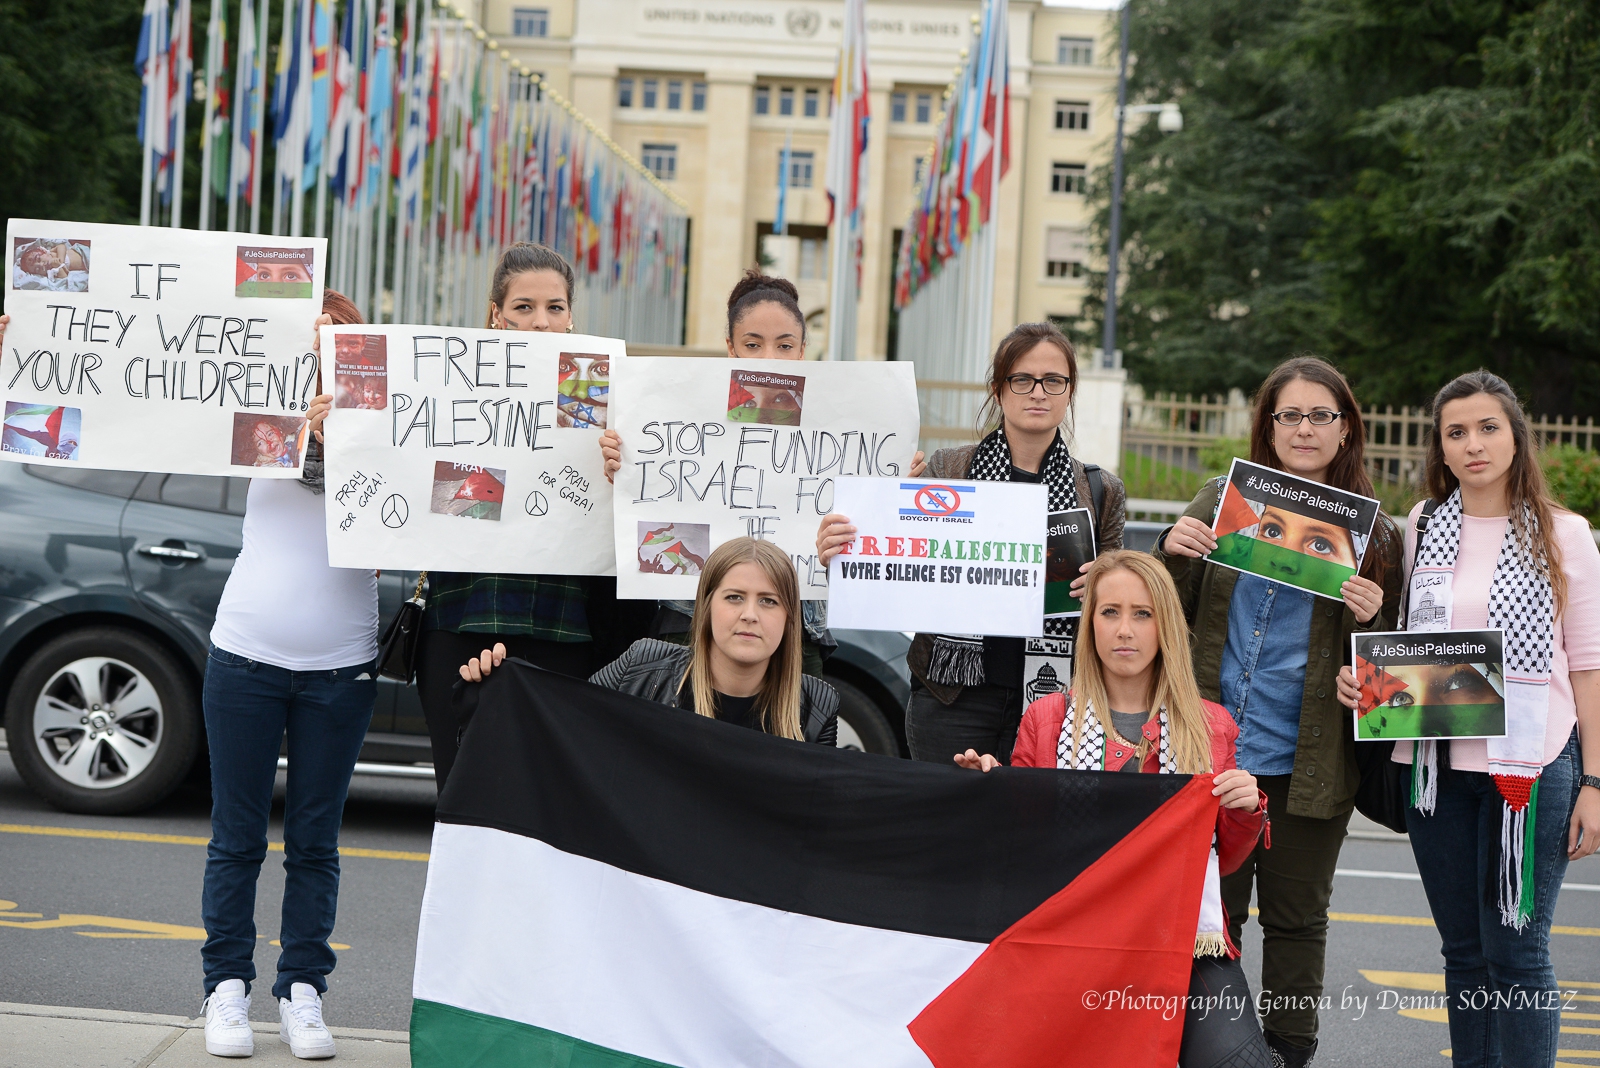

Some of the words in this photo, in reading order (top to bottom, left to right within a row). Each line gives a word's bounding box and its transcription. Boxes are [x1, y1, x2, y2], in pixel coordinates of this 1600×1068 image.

[828, 17, 905, 35] NONS
[244, 250, 306, 259] #JeSuisPalestine
[129, 263, 181, 301] IF
[46, 304, 137, 348] THEY
[156, 313, 268, 358] WERE
[7, 347, 103, 395] YOUR
[124, 352, 318, 412] CHILDREN!?
[412, 335, 529, 391] FREE
[738, 373, 797, 387] #JeSuisPalestine
[391, 393, 554, 452] PALESTINE
[637, 420, 726, 457] STOP
[736, 426, 900, 477] FUNDING
[453, 462, 484, 474] PRAY
[558, 465, 590, 493] PRAY
[335, 470, 368, 506] PRAY
[339, 512, 357, 532] FOR
[358, 472, 387, 507] GAZA!
[538, 470, 557, 488] FOR
[559, 486, 594, 516] GAZA!
[632, 459, 777, 510] ISRAEL
[795, 477, 835, 516] FO
[1246, 475, 1359, 519] #JeSuisPalestine
[899, 515, 940, 523] BOYCOTT
[841, 561, 881, 580] VOTRE
[885, 562, 936, 582] SILENCE
[940, 565, 962, 584] EST
[966, 566, 1029, 587] COMPLICE
[1371, 641, 1486, 658] #JeSuisPalestine
